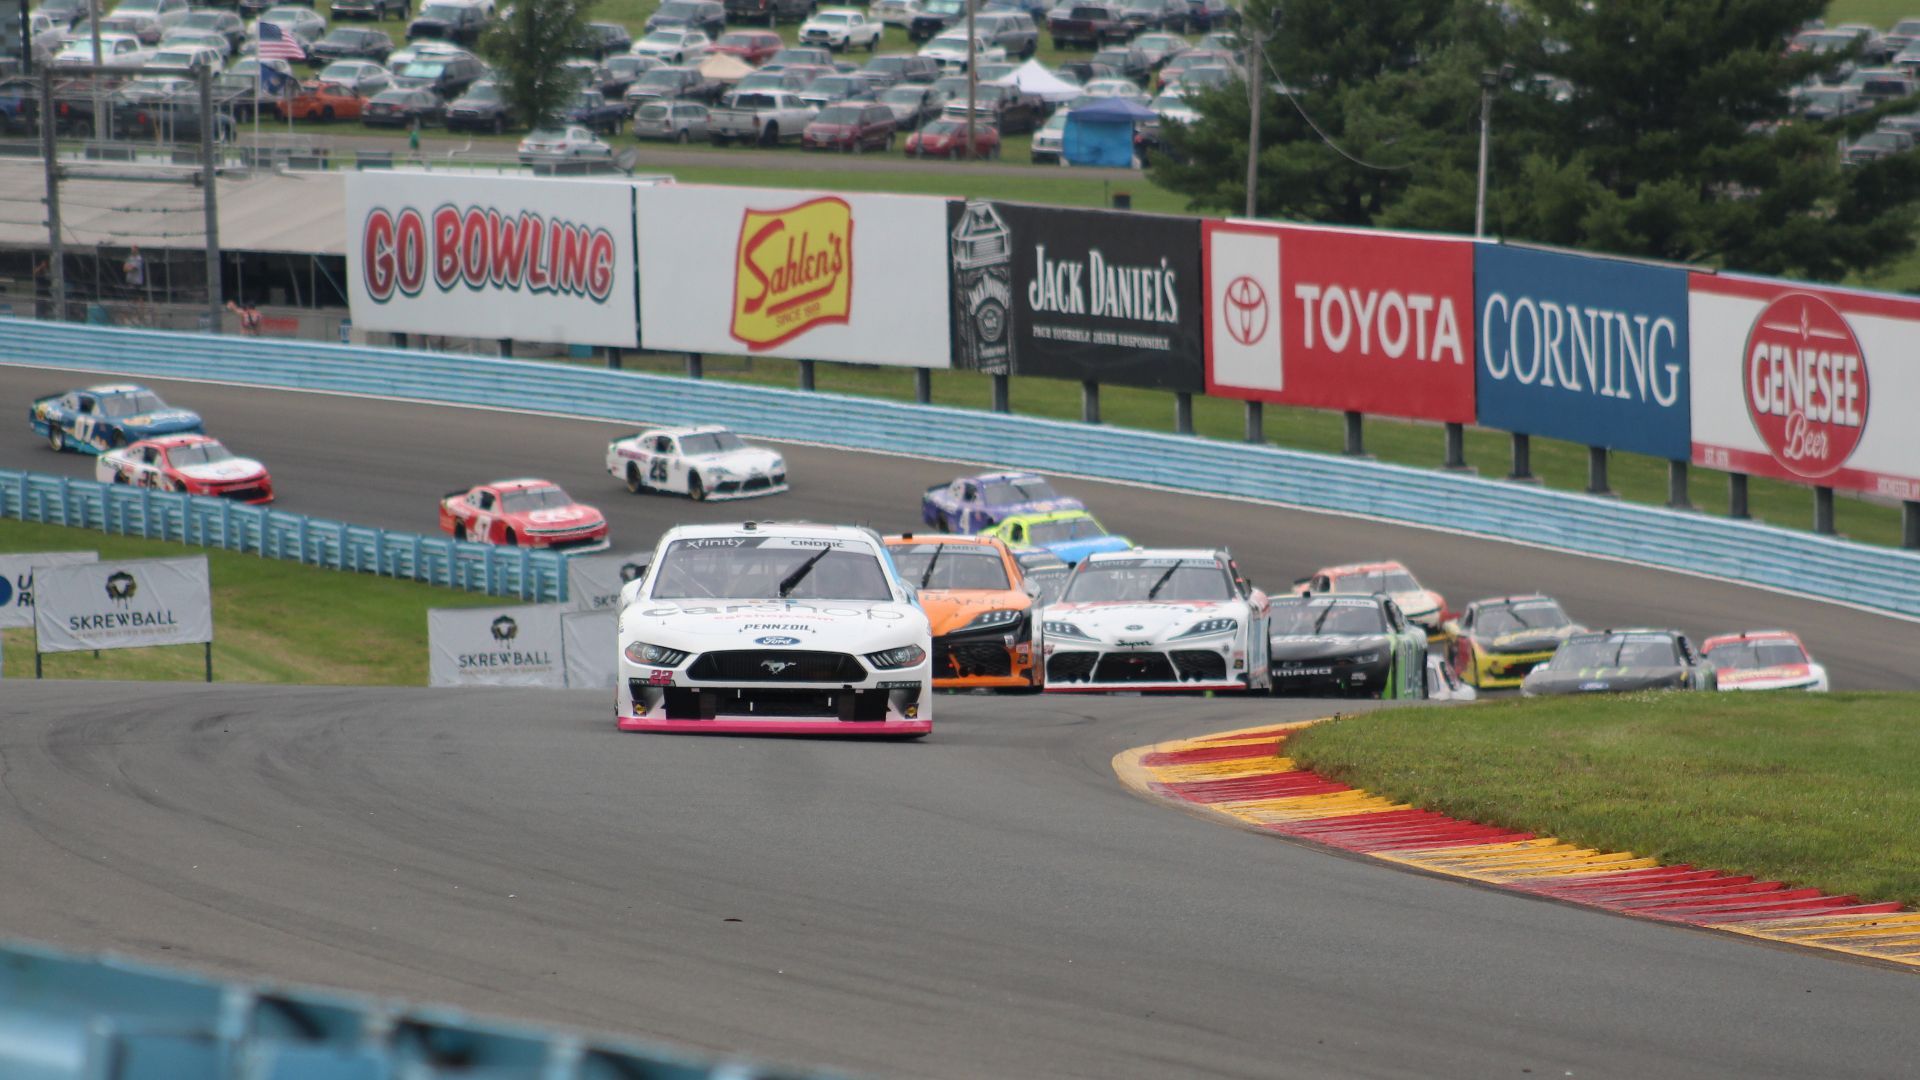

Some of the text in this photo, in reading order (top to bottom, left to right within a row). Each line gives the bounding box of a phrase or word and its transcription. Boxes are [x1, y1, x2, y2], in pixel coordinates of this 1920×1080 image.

[364, 203, 616, 303] GO BOWLING
[743, 218, 843, 314] Sahlen's
[1028, 244, 1178, 324] JACK DANIEL'S
[1295, 283, 1464, 365] TOYOTA
[1093, 331, 1117, 345] DRINK
[1483, 293, 1680, 407] CORNING
[1751, 342, 1861, 428] GENESEE
[75, 415, 96, 443] 07
[1783, 410, 1829, 461] Beer
[685, 537, 745, 549] xfinity
[791, 540, 844, 549] CINDRIC
[69, 608, 177, 631] SKREWBALL
[642, 603, 905, 620] carshop
[744, 623, 811, 632] PENNZOIL
[459, 651, 553, 668] SKREWBALL
[649, 669, 674, 685] 22
